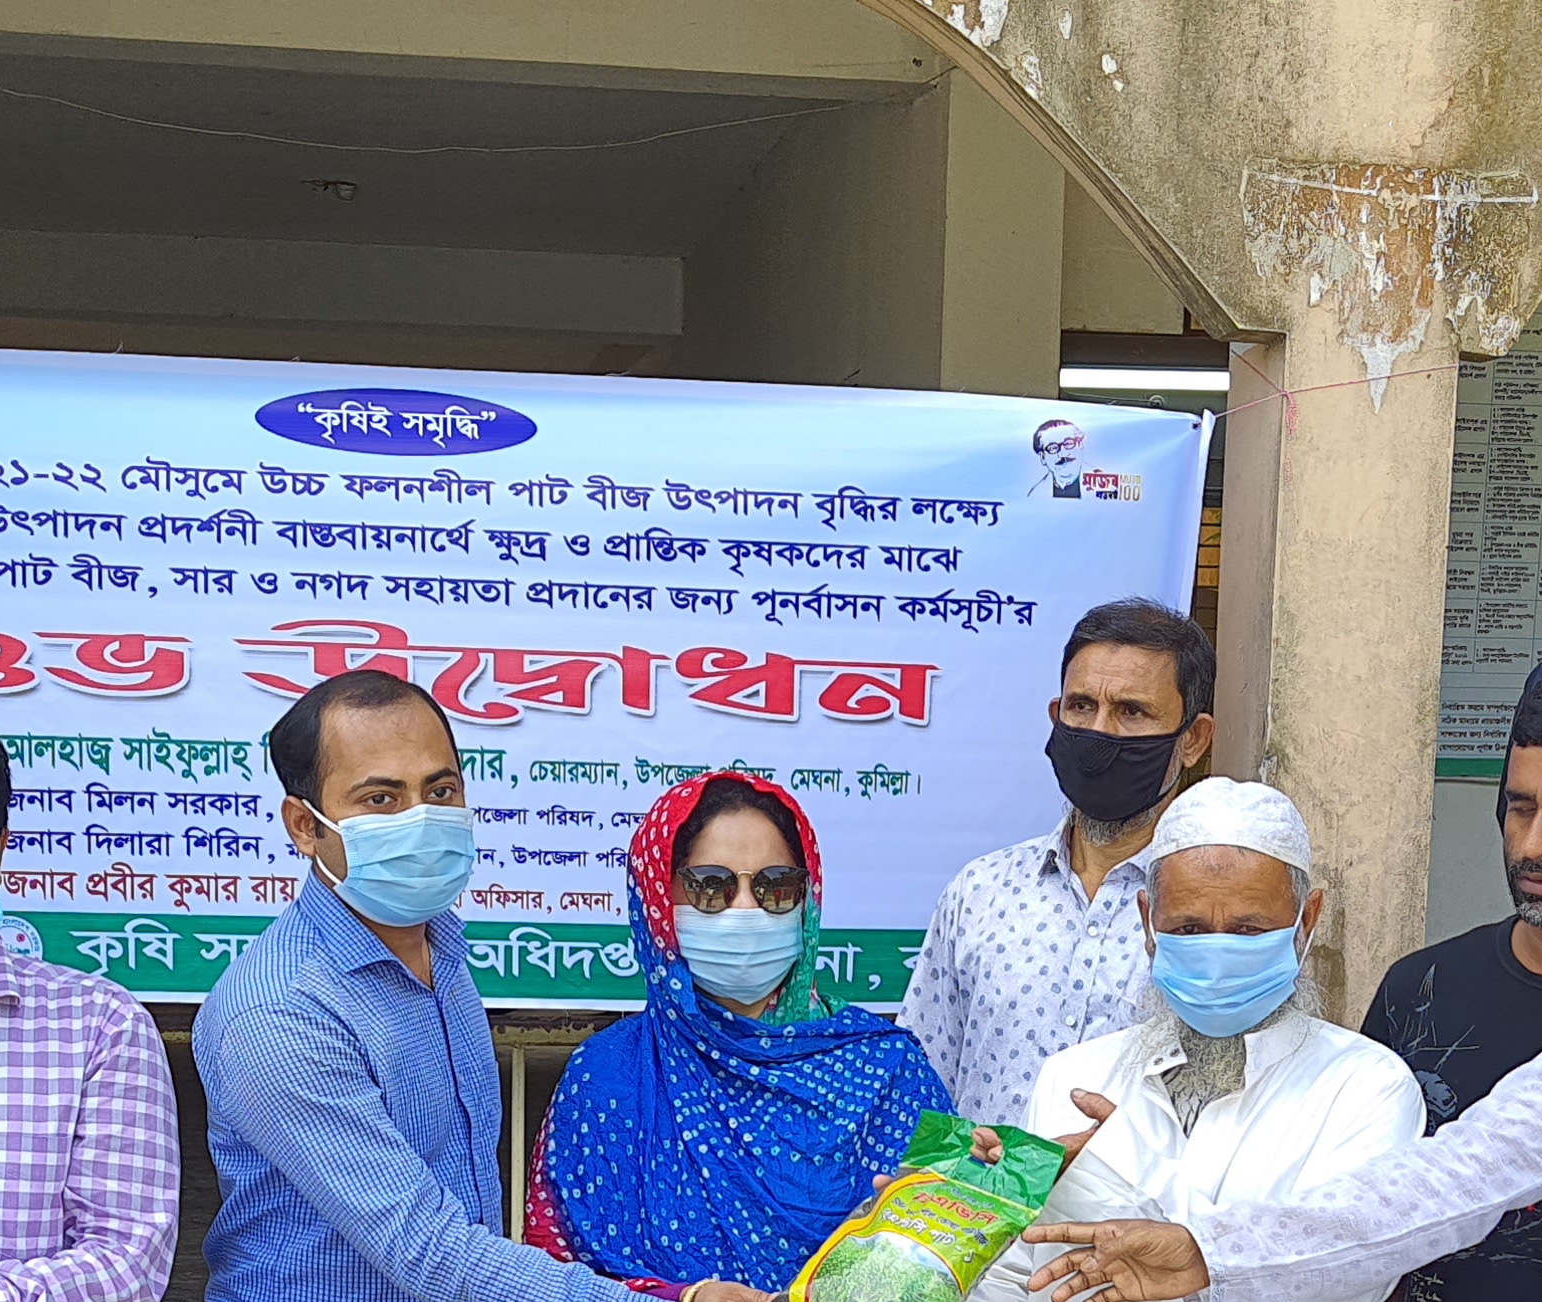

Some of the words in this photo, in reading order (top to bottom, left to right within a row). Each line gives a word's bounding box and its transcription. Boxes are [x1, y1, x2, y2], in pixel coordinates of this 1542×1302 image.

[121, 456, 246, 498] মৌসুমে
[258, 463, 326, 497] উচ্চ
[344, 467, 491, 509] ফলনশীল
[509, 473, 569, 508] পাট
[589, 469, 651, 512] বীজ
[664, 480, 803, 520] উৎপাদন
[813, 490, 898, 533] বৃদ্ধির
[912, 498, 1005, 528] লক্ষ্যে
[137, 508, 259, 546] প্রদর্শনী
[275, 514, 469, 562] বাস্তবায়নার্থে
[487, 525, 547, 567] ক্ষুদ্র
[568, 534, 591, 558] ও
[603, 523, 707, 567] প্রান্তিক
[721, 538, 867, 576] কৃষকদের
[883, 540, 963, 575] মাঝে
[70, 552, 159, 599] বীজ,
[172, 565, 235, 597] সার
[252, 569, 279, 597] ও
[293, 568, 369, 604] নগদ
[385, 571, 513, 607] সহায়তা
[525, 578, 653, 613] প্রদানের
[669, 585, 734, 618] জন্য
[751, 582, 883, 629] পূনর্বাসন
[232, 619, 945, 724] উদ্বোধন
[0, 731, 113, 775] আলহাজ্ব
[460, 746, 519, 789] দার,
[529, 757, 628, 789] চেয়ারম্যান,
[790, 767, 850, 796] মেঘনা,
[8, 786, 76, 813] জনাব
[82, 781, 158, 815] মিলন
[165, 791, 275, 822] সরকার,
[472, 806, 529, 826] পজেলা
[536, 805, 604, 830] পরিষদ,
[611, 811, 646, 828] মেঘ
[6, 829, 75, 855] জনাব
[83, 823, 172, 856] দিলারা
[182, 826, 275, 864] শিরিন,
[512, 844, 589, 868] উপজেলা
[595, 847, 628, 868] পরি
[0, 869, 77, 900] জনাব
[86, 862, 157, 901] প্রবীর
[164, 871, 241, 911] কুমার
[249, 874, 299, 903] রায়
[471, 884, 553, 914] অফিসার,
[560, 889, 621, 916] মেঘনা,
[72, 917, 182, 976] কৃষি
[465, 927, 642, 981] অধিদপ্ত
[815, 944, 882, 990] না,
